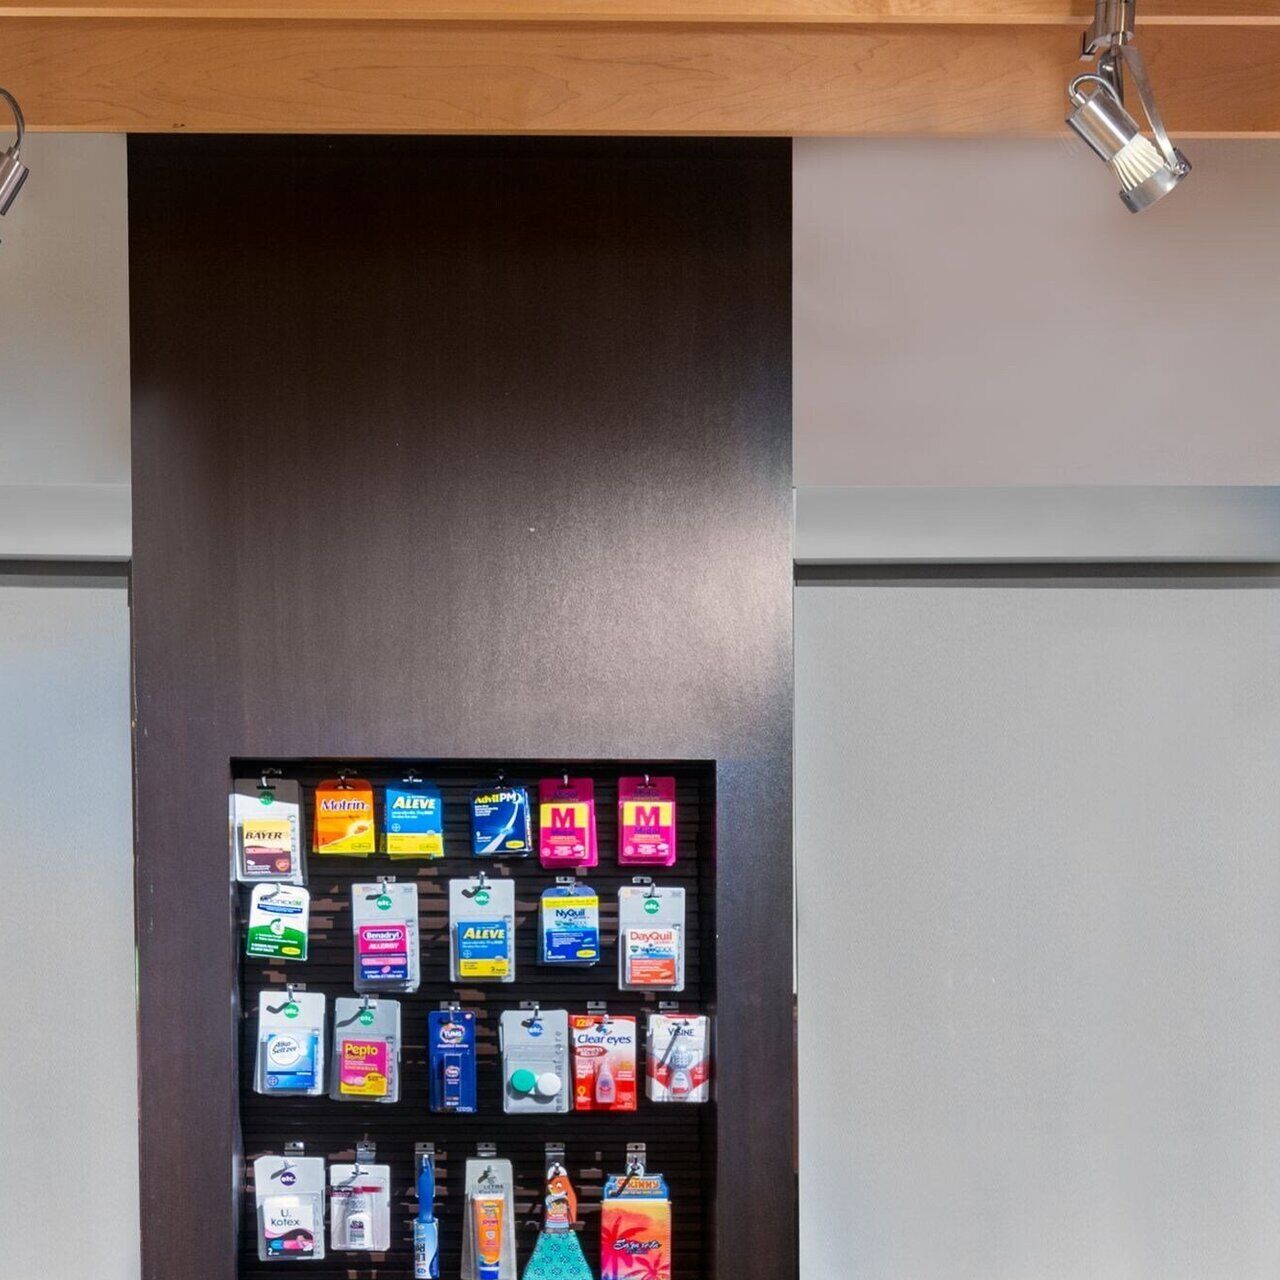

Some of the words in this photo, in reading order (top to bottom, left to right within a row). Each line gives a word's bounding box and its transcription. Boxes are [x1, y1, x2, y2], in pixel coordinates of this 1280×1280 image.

[392, 796, 435, 809] ALEVE
[499, 793, 517, 802] PM
[322, 799, 366, 811] Motrin
[552, 807, 576, 828] M
[635, 806, 661, 827] M
[245, 831, 282, 840] BAYER
[556, 909, 585, 919] NyQuil
[366, 931, 400, 940] Benadryl
[463, 927, 505, 940] ALEVE
[631, 931, 672, 942] DayQuil
[443, 1029, 463, 1038] TUMS
[577, 1034, 605, 1044] Clear
[607, 1034, 632, 1046] eyes
[345, 1043, 378, 1056] Pepto
